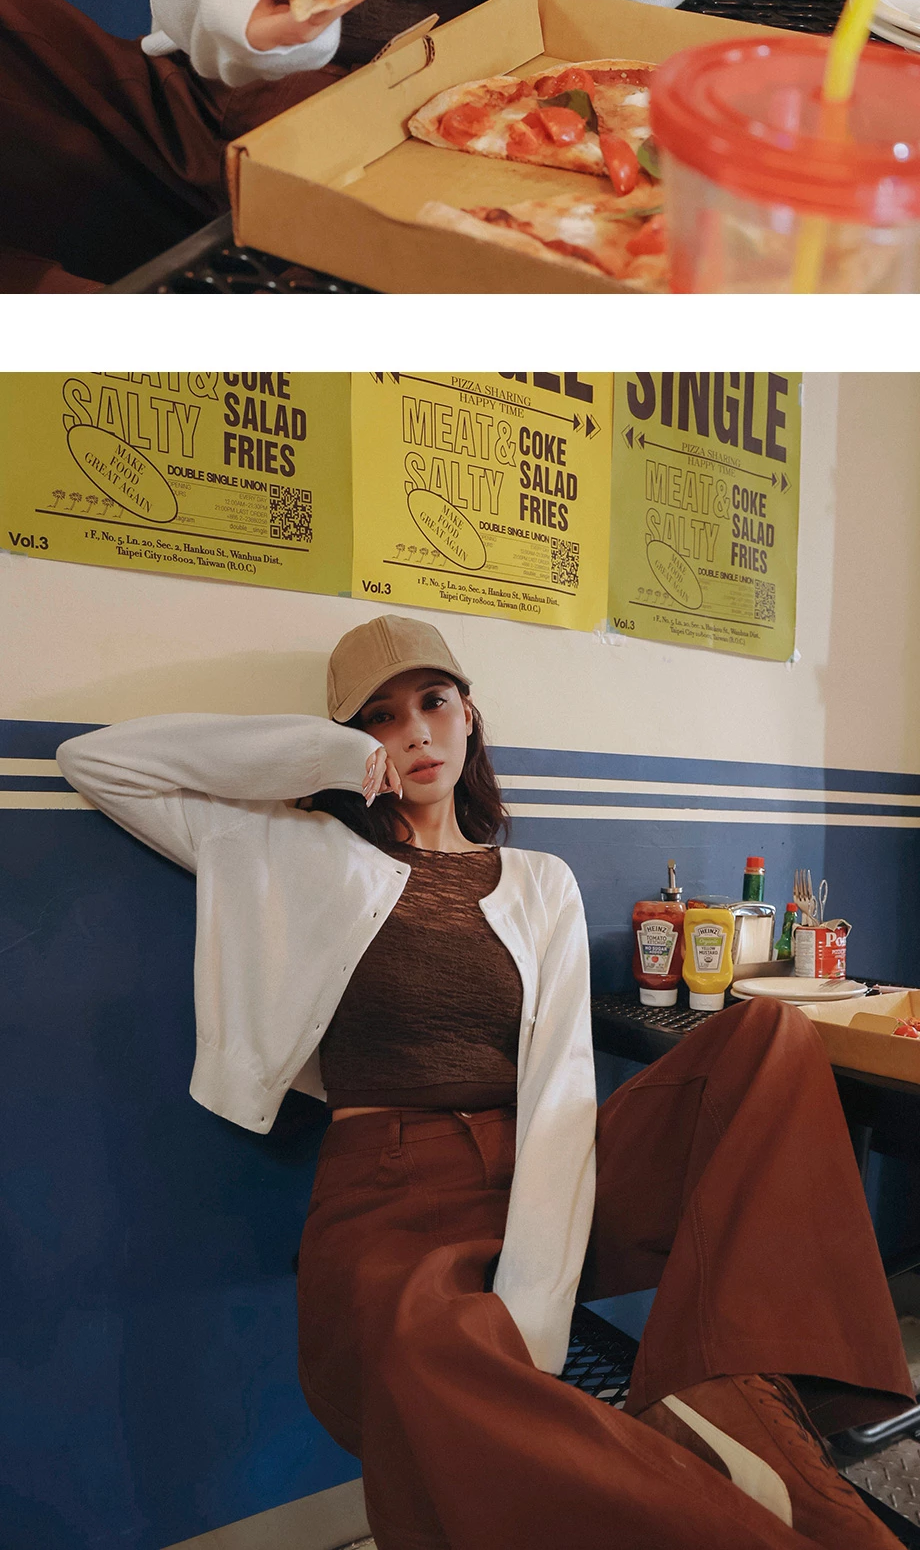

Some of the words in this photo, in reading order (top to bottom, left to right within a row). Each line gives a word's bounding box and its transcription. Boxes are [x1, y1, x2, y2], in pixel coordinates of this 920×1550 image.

[451, 376, 481, 393] PIZZA
[484, 385, 531, 406] SHARING
[459, 393, 496, 410] HAPPY
[499, 404, 524, 418] TIME
[63, 378, 201, 458] SALTY
[223, 392, 306, 442] SALAD
[402, 395, 517, 467] MEAT&
[115, 445, 146, 475] MAKE
[223, 431, 296, 477] FRIES
[519, 426, 567, 466] COKE
[84, 452, 120, 485] GREAT
[119, 482, 152, 513] AGAIN
[110, 456, 139, 485] FOOD
[167, 465, 205, 481] DOUBLE
[207, 473, 238, 487] SINGLE
[240, 479, 267, 492] UNION
[404, 451, 504, 515] SALTY
[519, 460, 577, 501] SALAD
[520, 493, 568, 532] FRIES
[732, 484, 766, 518] COKE
[8, 531, 48, 550] Vol.3
[732, 513, 774, 548] SALAD
[116, 546, 142, 559] Taipei
[143, 552, 161, 563] City
[163, 555, 195, 565] 108002,
[197, 557, 226, 569] Taiwan
[227, 561, 256, 574] (R.O.C.)
[731, 542, 768, 574] FRIES
[362, 580, 391, 595] Vol.3
[613, 617, 635, 630] Vol.3
